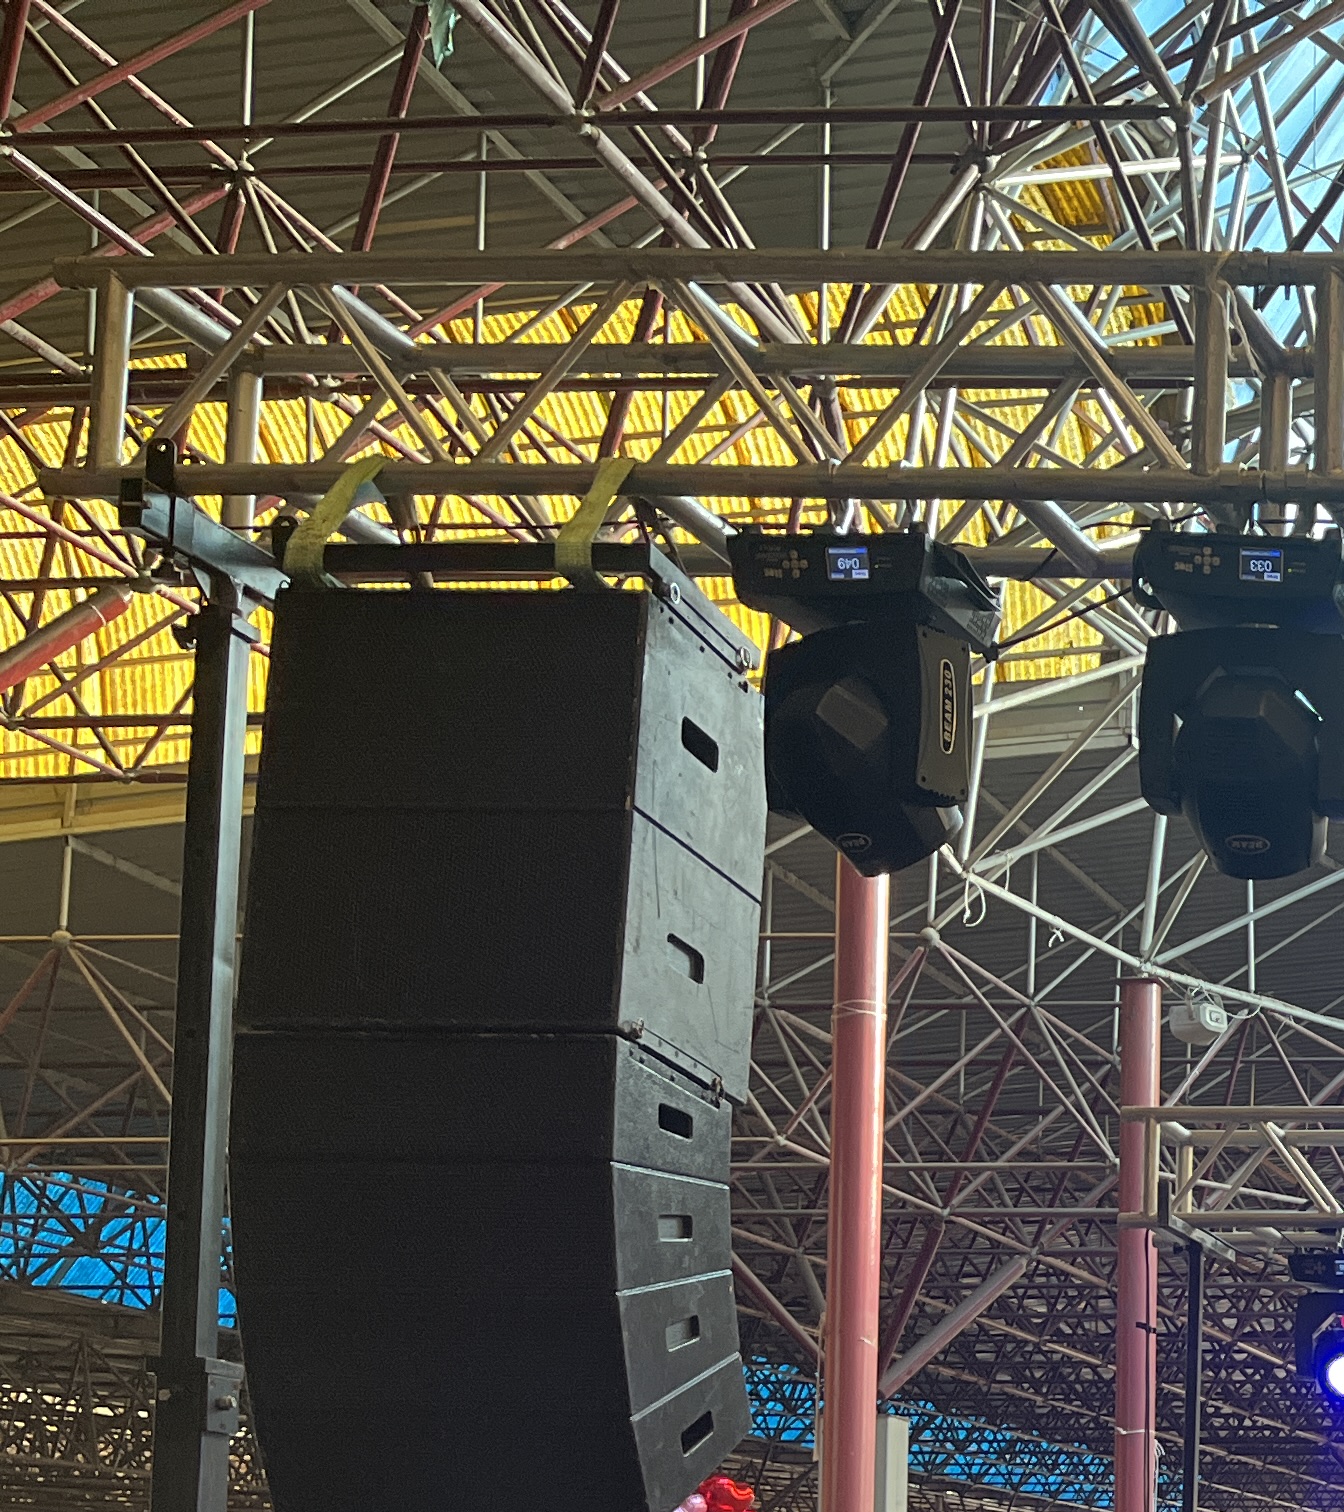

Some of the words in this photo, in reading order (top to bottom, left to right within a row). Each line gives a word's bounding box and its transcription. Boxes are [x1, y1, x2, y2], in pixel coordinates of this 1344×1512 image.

[838, 558, 860, 570] 049
[1250, 559, 1273, 572] 033
[943, 668, 953, 696] 230
[943, 703, 953, 743] BEAM
